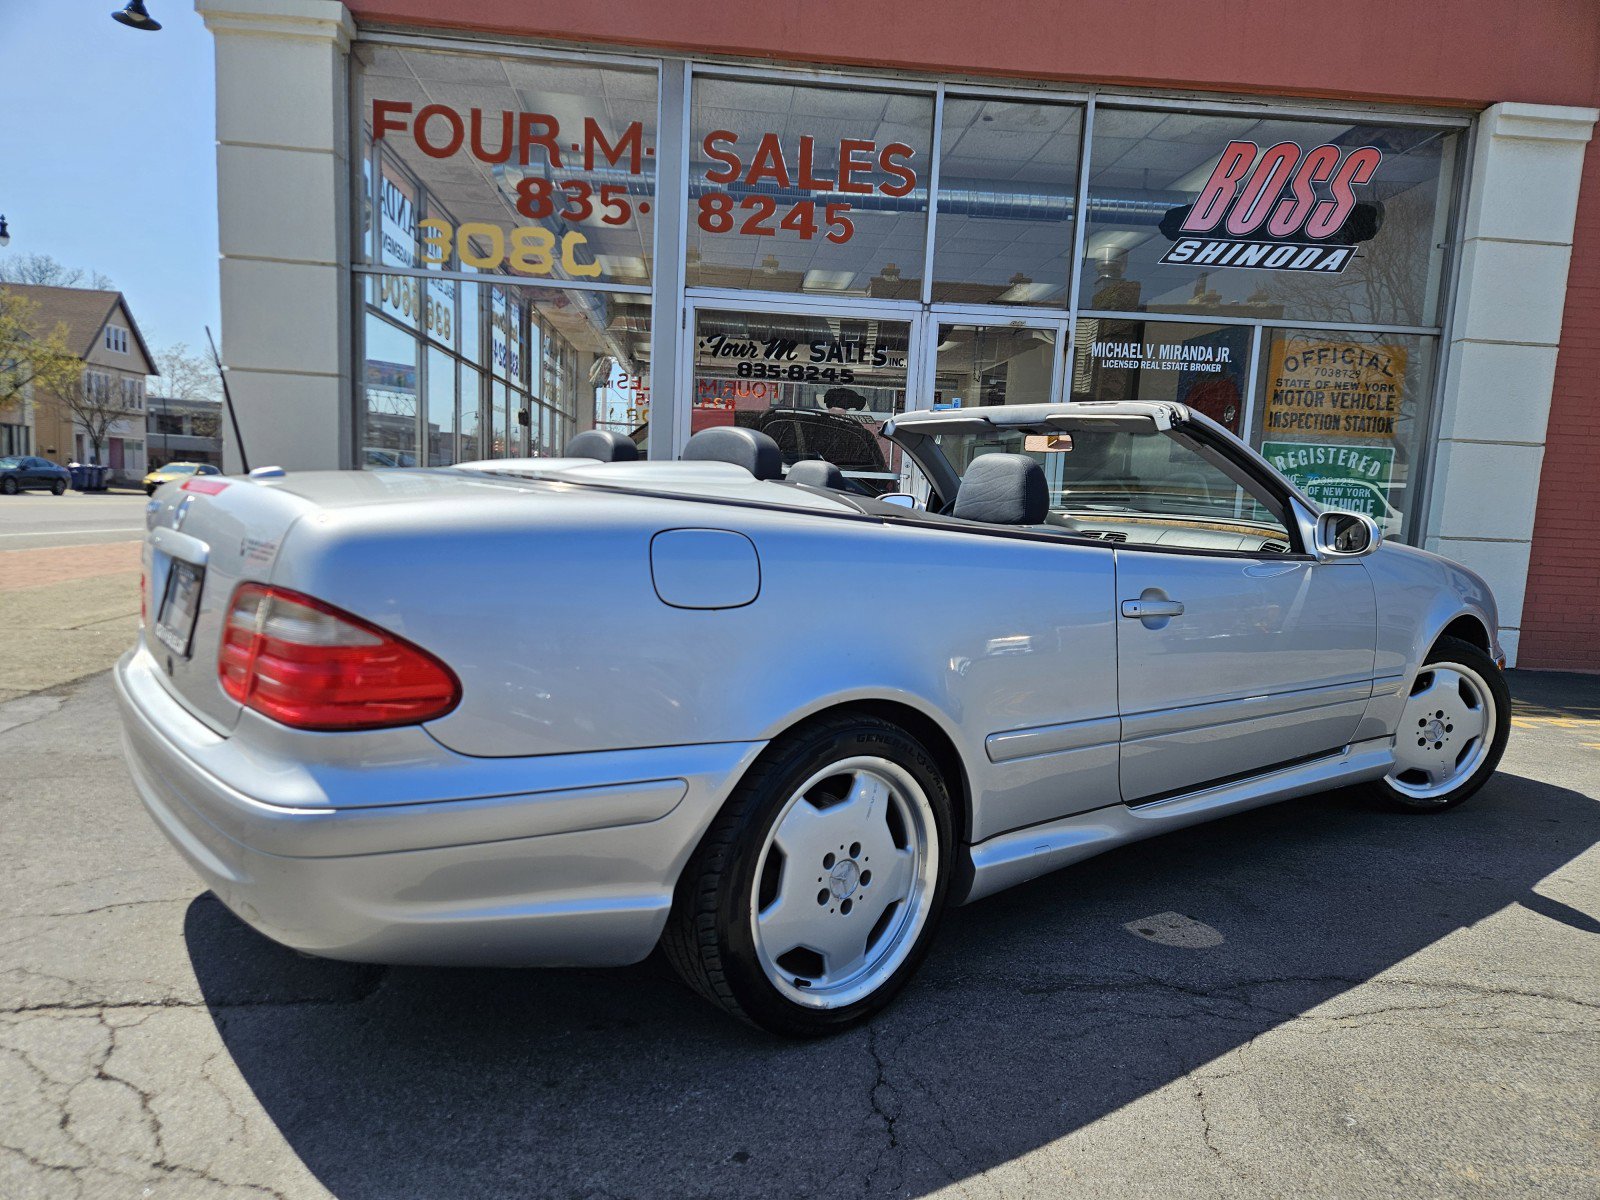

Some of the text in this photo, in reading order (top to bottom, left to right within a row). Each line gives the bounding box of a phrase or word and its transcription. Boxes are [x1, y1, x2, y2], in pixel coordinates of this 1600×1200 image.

[372, 99, 565, 168] FOUR
[703, 129, 918, 198] SALES
[1178, 140, 1383, 239] BOSS
[697, 192, 855, 245] 8245
[1167, 240, 1350, 272] SHINODA
[809, 339, 889, 367] SALES
[1091, 342, 1233, 363] MICHAEL V. MIRANDA JR.
[1102, 359, 1222, 373] LICENSED REAL ESTATE BROKER
[1284, 347, 1394, 377] OFFICIAL
[1276, 378, 1396, 393] STATE OF NEW YORK
[1272, 389, 1396, 412] MOTOR VEHICLE
[1268, 411, 1395, 434] INSPECTION STATION
[1274, 447, 1381, 477] REGISTERED
[1308, 486, 1319, 496] OF
[1323, 487, 1344, 498] NEW
[1346, 487, 1371, 498] YORK
